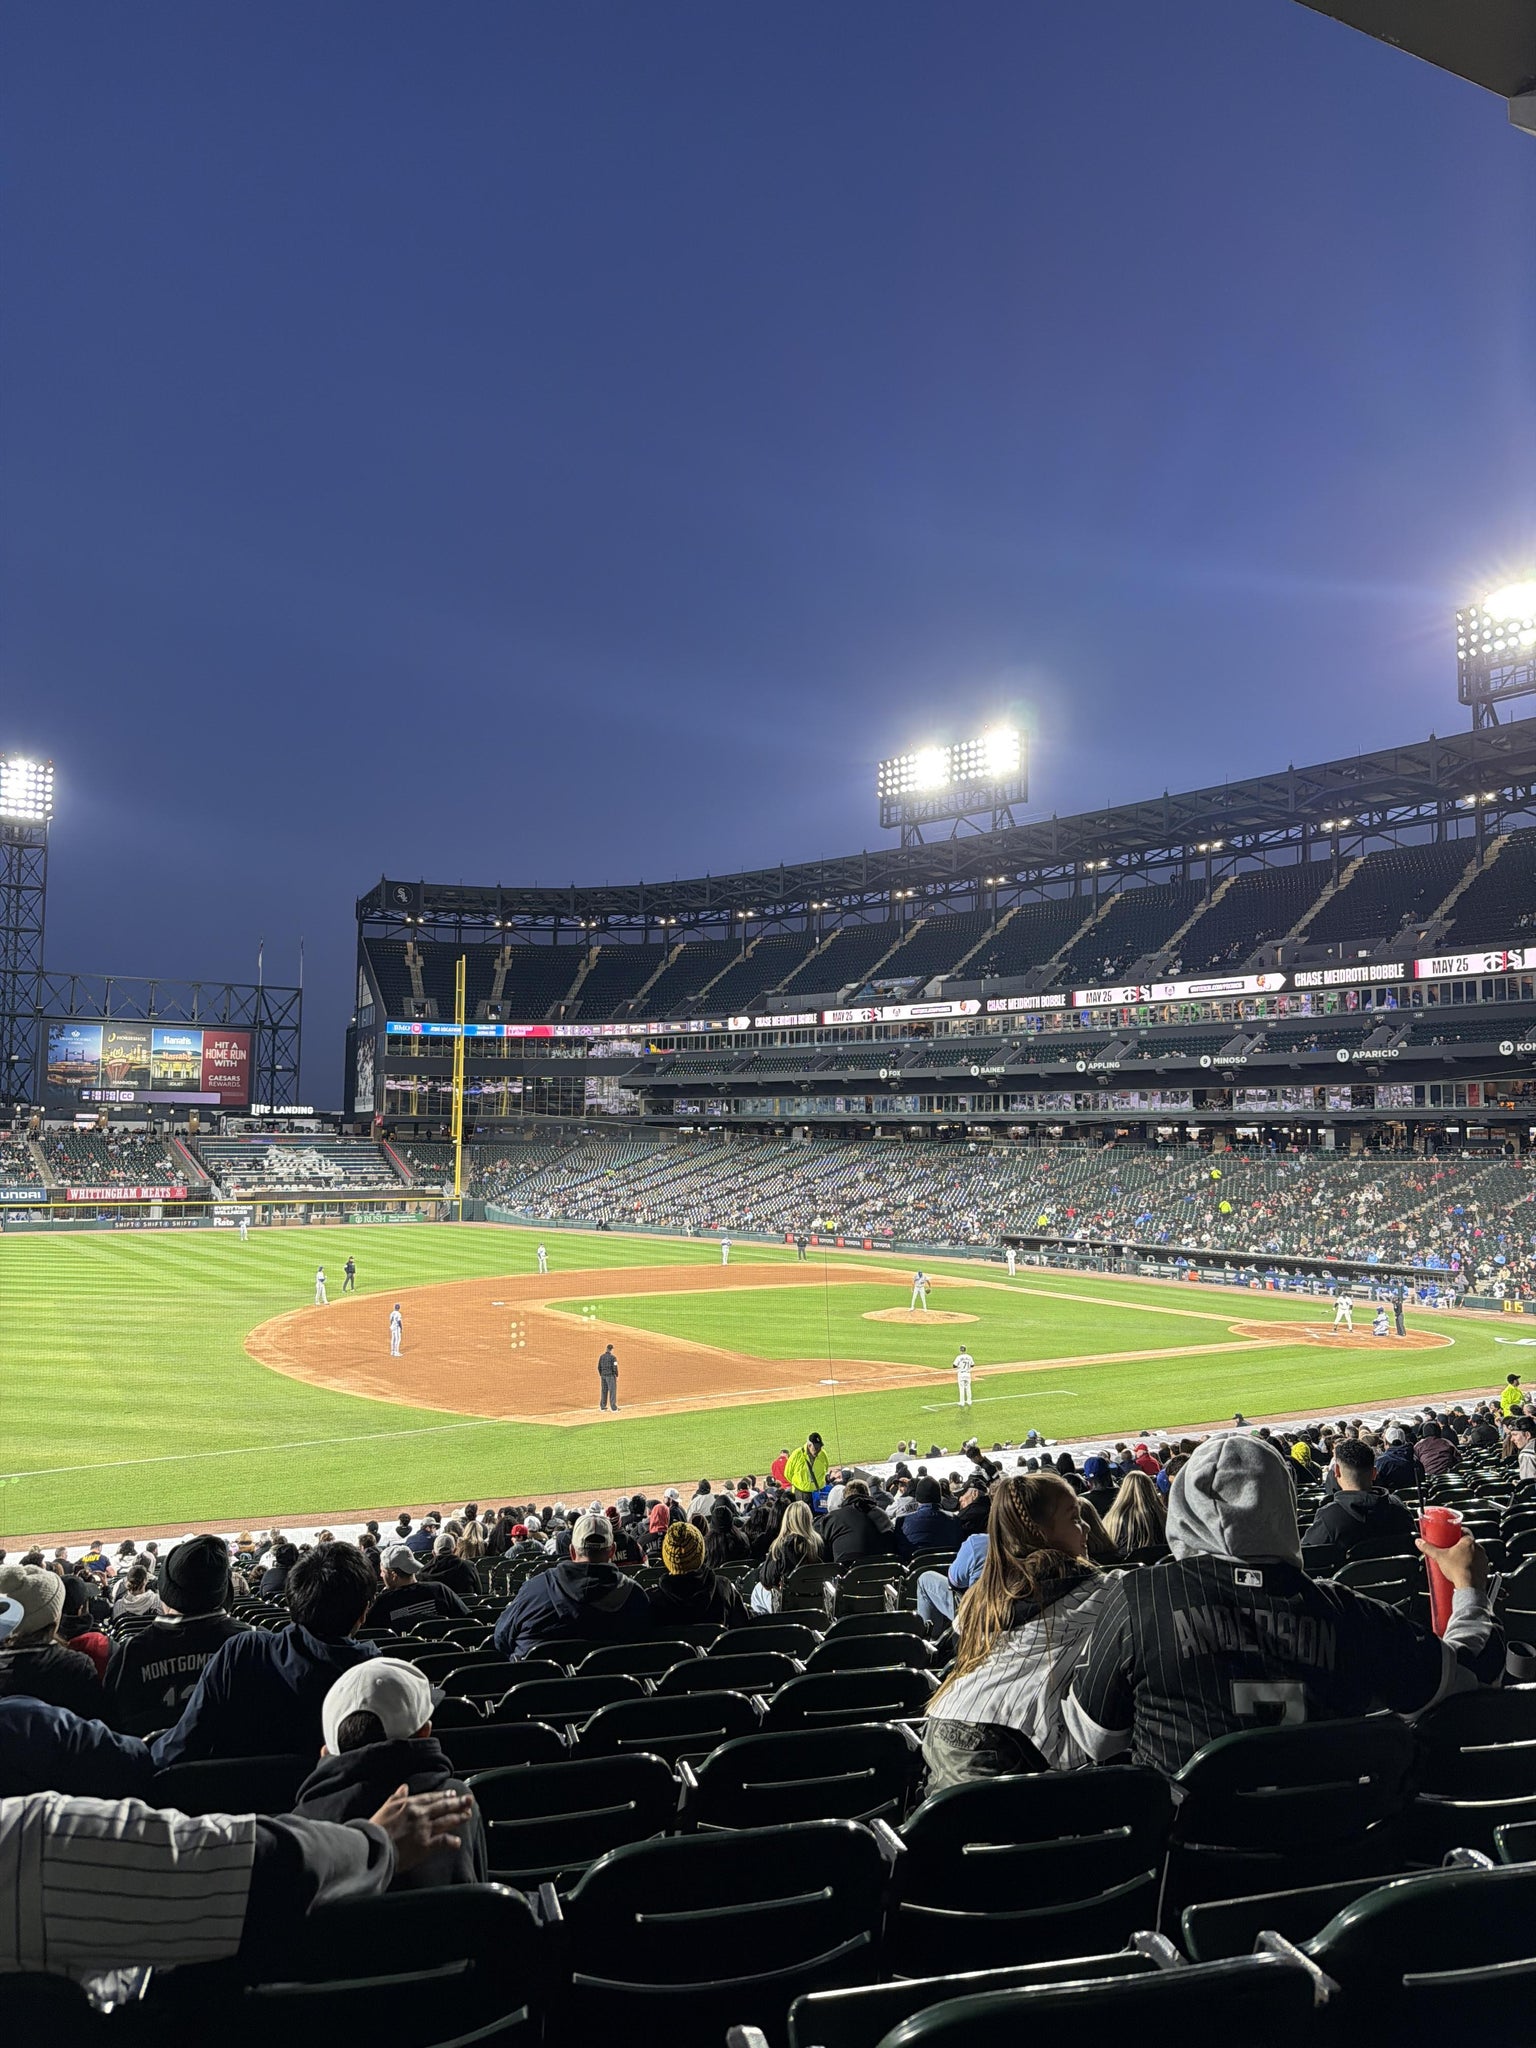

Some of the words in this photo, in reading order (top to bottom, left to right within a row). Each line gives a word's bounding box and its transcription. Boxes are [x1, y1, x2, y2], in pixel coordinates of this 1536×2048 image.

[1432, 959, 1454, 975] MAY
[1456, 957, 1469, 972] 25
[1294, 971, 1324, 987] CHASE
[1324, 967, 1368, 985] MEIDROTH
[1369, 963, 1405, 981] BOBBLE
[1086, 992, 1101, 1004] MAY
[1102, 990, 1112, 1003] 25
[987, 999, 1007, 1012] CHASE
[1007, 997, 1040, 1010] MEIDROTH
[1040, 994, 1066, 1007] BOBBLE
[832, 1012, 845, 1022] MAY
[846, 1011, 853, 1021] 25
[215, 1041, 229, 1049] HIT
[206, 1049, 228, 1059] HOME
[230, 1049, 246, 1060] RUN
[1352, 1049, 1399, 1059] APARICIO
[981, 1066, 1005, 1074] BAINES
[1088, 1061, 1120, 1069] APPLING
[251, 1103, 271, 1116] Lite
[273, 1105, 314, 1114] LANDING
[0, 1191, 41, 1199] UNDAI
[71, 1187, 137, 1200] WHITTINGHAM
[141, 1187, 171, 1198] MEATS
[364, 1215, 386, 1223] RUSH
[82, 1554, 100, 1563] NAVY
[1173, 1604, 1337, 1671] ANDERSON
